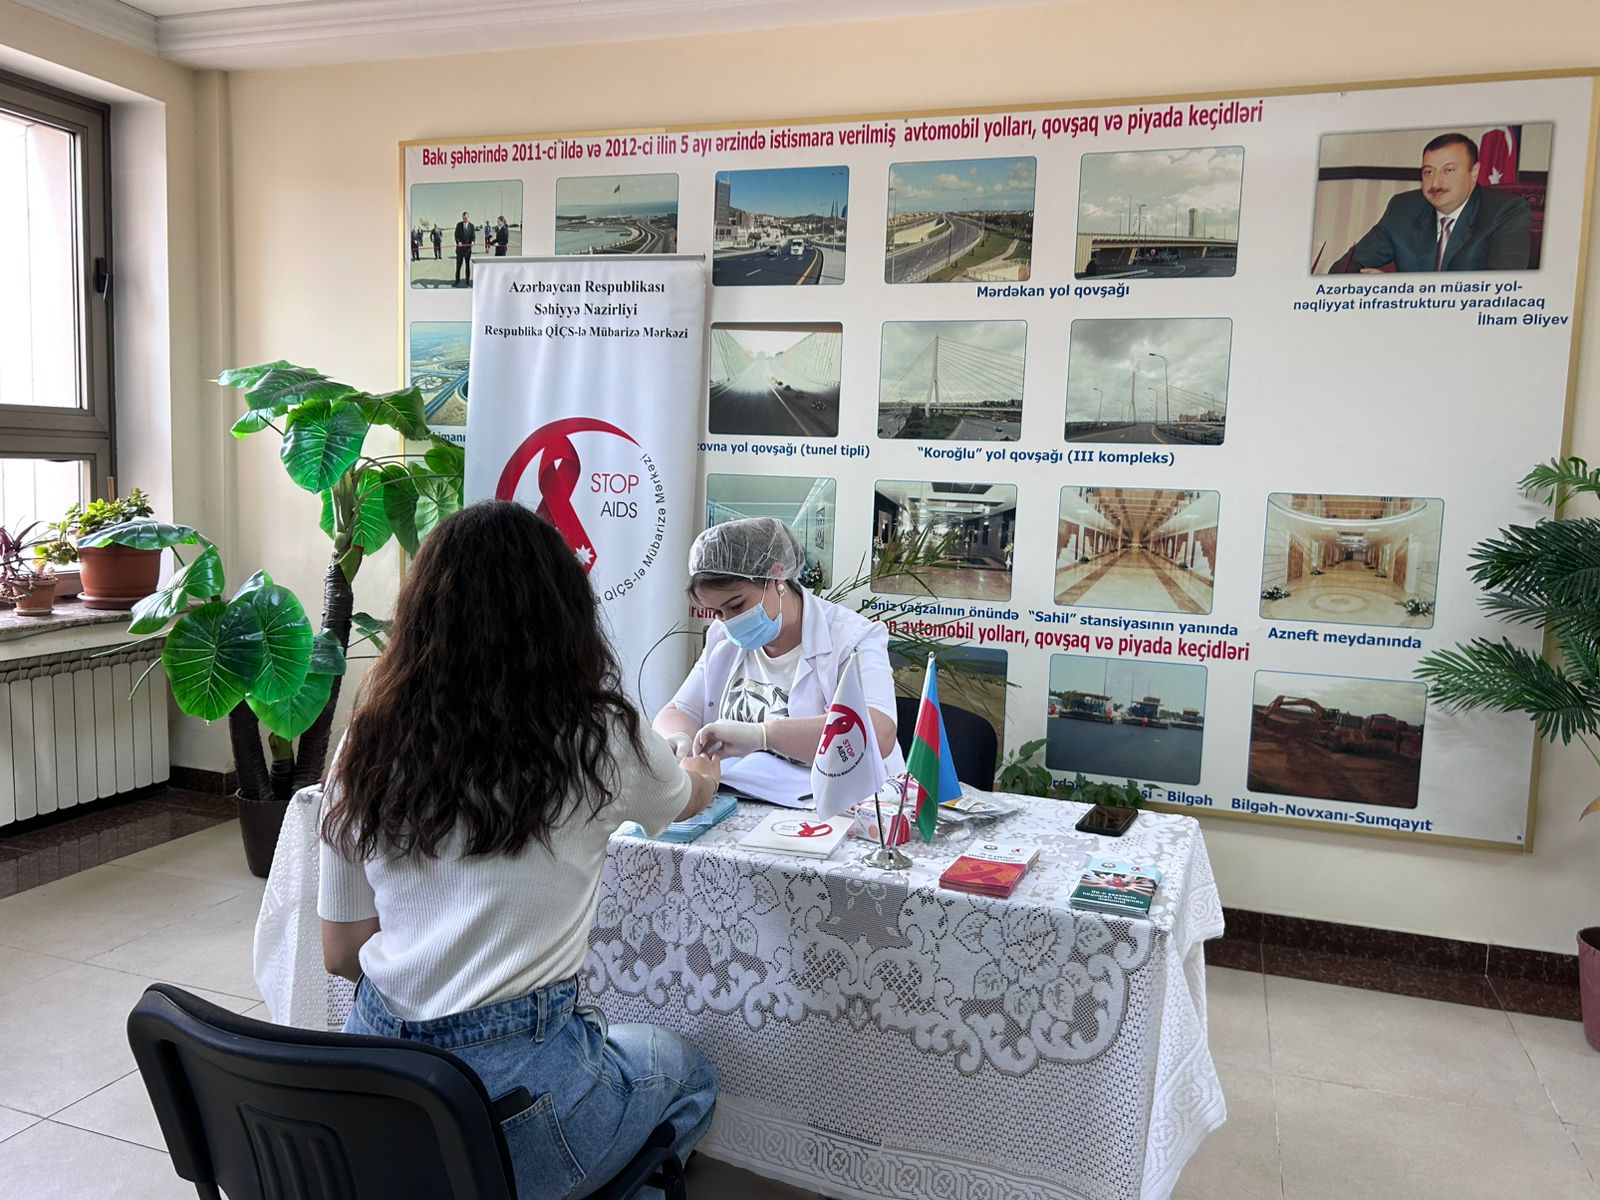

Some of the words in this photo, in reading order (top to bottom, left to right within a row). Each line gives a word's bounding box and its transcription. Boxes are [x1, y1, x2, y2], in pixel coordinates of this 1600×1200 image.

[422, 148, 447, 166] Bakı
[450, 144, 508, 168] şəhərində
[512, 141, 557, 162] 2011-ci
[561, 140, 583, 160] ildə
[587, 145, 601, 158] və
[606, 136, 652, 157] 2012-ci
[657, 135, 677, 155] ilin
[680, 135, 689, 153] 5
[692, 137, 712, 157] ayı
[715, 131, 766, 152] ərzində
[770, 128, 834, 149] istismara
[839, 122, 896, 147] verilmiş
[904, 117, 980, 142] avtomobil
[984, 116, 1036, 142] yolları,
[1041, 115, 1099, 139] qovşaq
[1104, 113, 1122, 131] və
[1127, 106, 1183, 135] piyada
[1188, 100, 1264, 130] keçidləri
[509, 281, 581, 296] Azərbaycan
[585, 280, 665, 296] Respublikası
[977, 285, 1045, 298] Mərdəkan
[1050, 284, 1069, 299] yol
[1074, 282, 1130, 299] qovşağı
[1316, 282, 1414, 297] Azərbaycanda
[1419, 284, 1436, 294] ən
[1440, 281, 1491, 293] müasir
[1494, 280, 1523, 295] yol-
[534, 303, 580, 318] Səhiyyə
[583, 303, 638, 318] Nazirliyi
[1293, 299, 1355, 312] nəqliyyat
[1359, 297, 1456, 310] infrastrukturu
[1460, 296, 1545, 311] yaradılacaq
[1477, 312, 1517, 326] İlham
[1522, 313, 1569, 328] Əliyev
[484, 324, 543, 339] Respublika
[545, 323, 587, 340] QİÇS-lə
[589, 325, 640, 339] Mübarizə
[643, 326, 689, 339] Mərkəzi
[731, 442, 748, 455] yol
[751, 442, 797, 457] qovşağı
[800, 443, 837, 457] (tunel
[840, 444, 871, 459] tipli)
[985, 449, 1006, 462] yol
[1010, 449, 1063, 464] qovşağı
[1067, 450, 1094, 465] (III
[1099, 450, 1175, 466] kompleks)
[591, 473, 639, 494] STOP
[640, 453, 666, 504] Mərkəzi
[600, 501, 638, 519] AIDS
[642, 507, 667, 568] Mübarizə
[900, 601, 965, 617] vağzalının
[969, 606, 1019, 621] önündə
[1080, 615, 1175, 631] stansiyasının
[1179, 622, 1238, 636] yanında
[902, 618, 974, 640] avtomobil
[978, 624, 1030, 648] yolları,
[1034, 630, 1090, 652] qovşaq
[1095, 635, 1114, 650] və
[1118, 633, 1172, 657] piyada
[1178, 637, 1250, 662] keçidləri
[1268, 627, 1319, 642] Azneft
[1323, 632, 1422, 649] meydanında
[836, 745, 849, 763] AIDS
[842, 738, 855, 758] STOP
[1167, 790, 1213, 806] Bilgəh
[1231, 798, 1433, 832] Bilgəh-Novxanı-Sumqayıt
